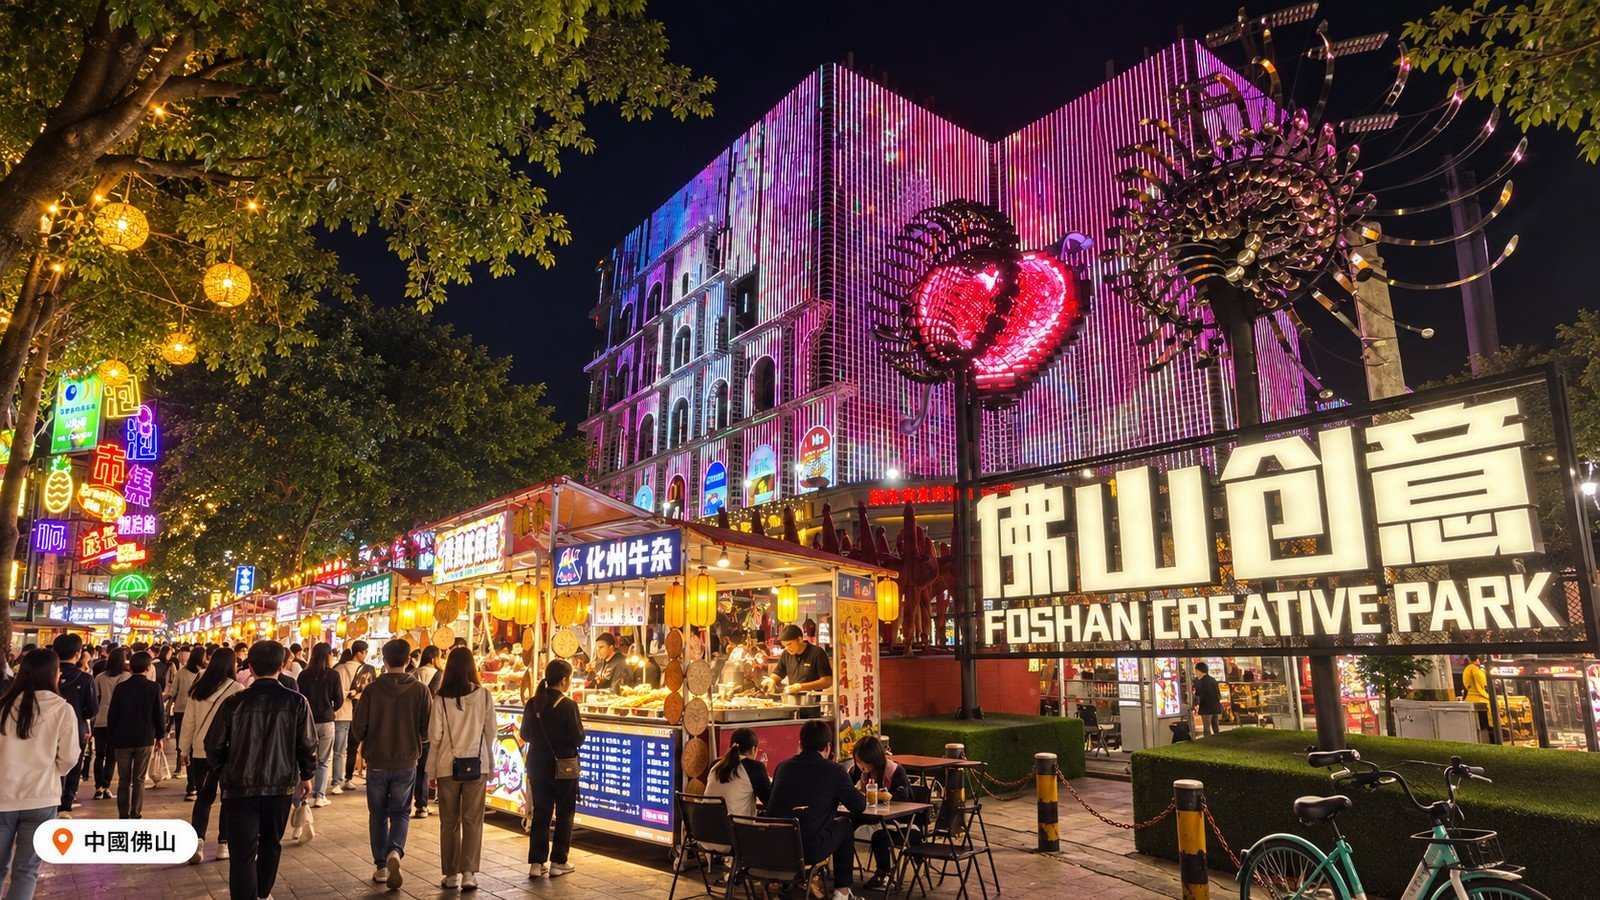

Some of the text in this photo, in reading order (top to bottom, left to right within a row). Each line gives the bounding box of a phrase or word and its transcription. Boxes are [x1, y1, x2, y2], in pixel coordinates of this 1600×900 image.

[93, 443, 127, 487] 市
[976, 397, 1536, 599] 佛山创意
[586, 536, 673, 581] 化州牛杂
[984, 572, 1562, 645] FOSHAN CREATIVE PARK
